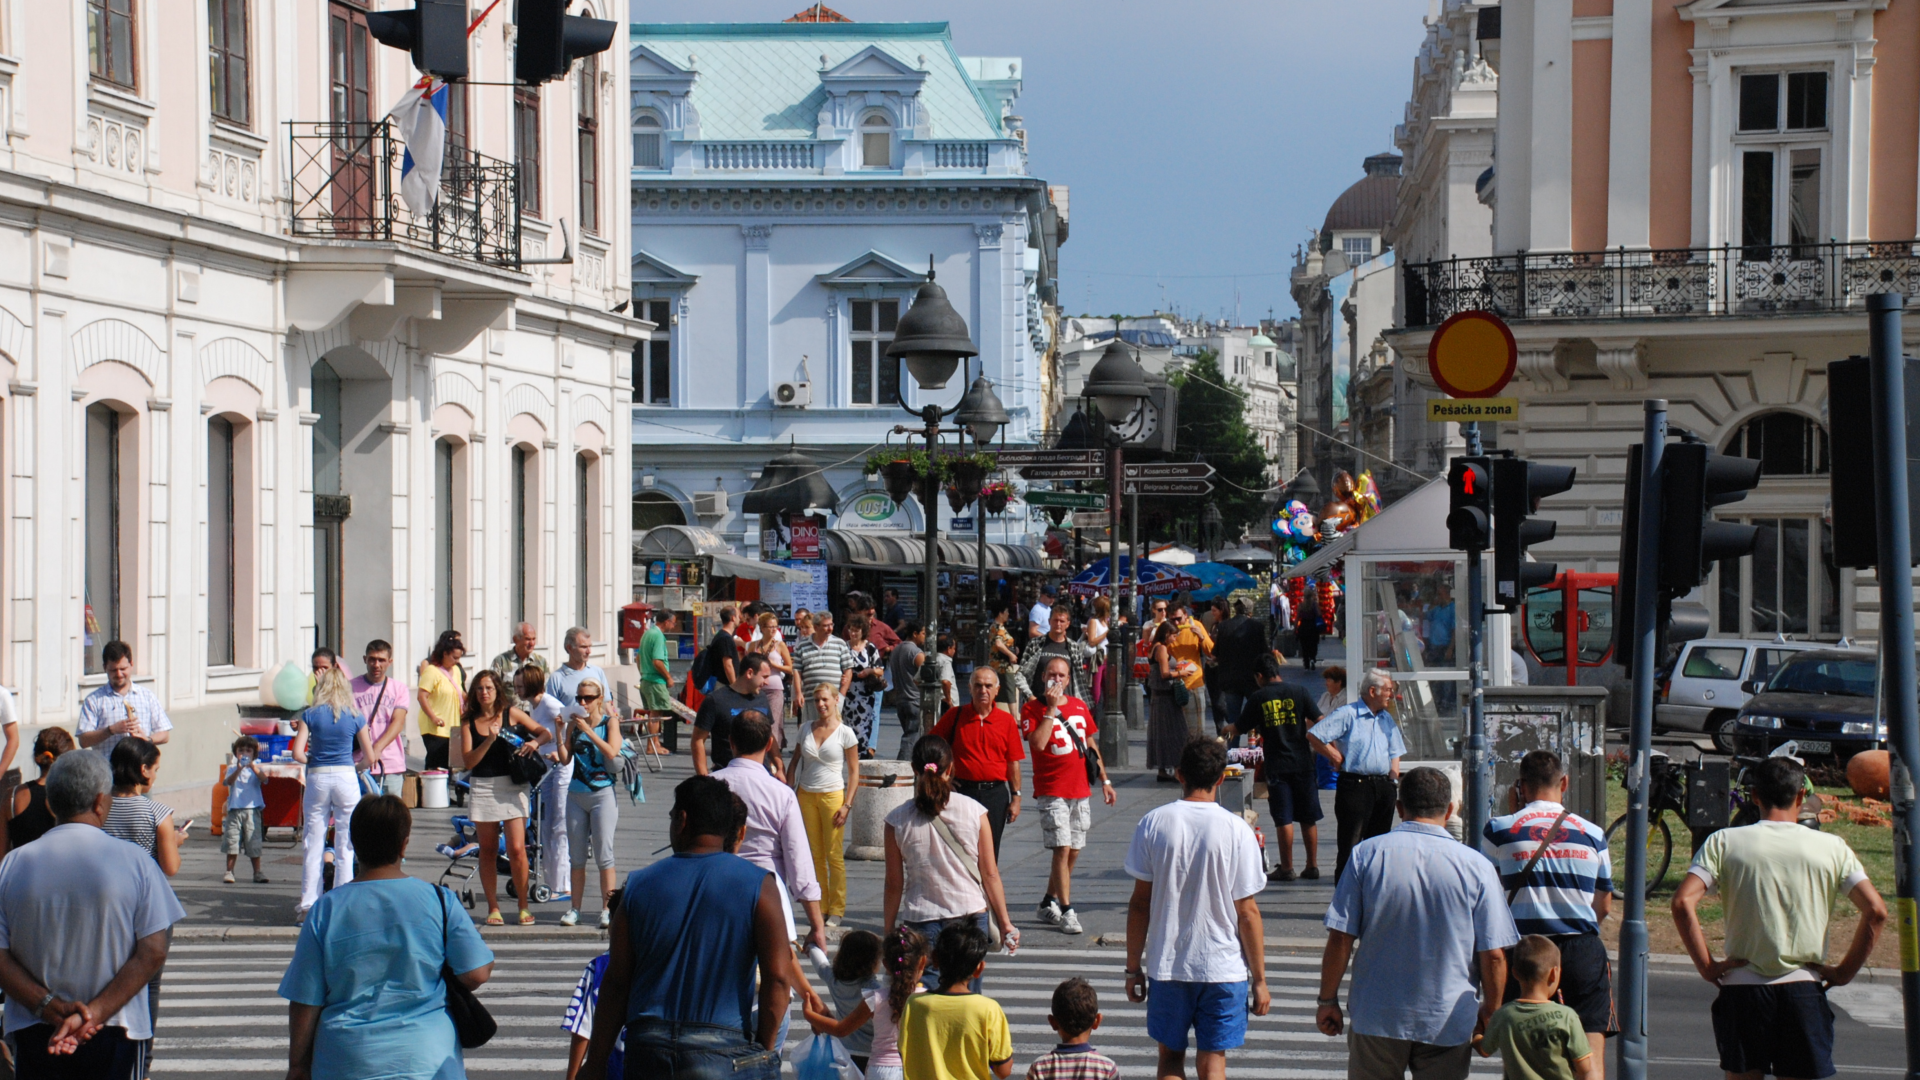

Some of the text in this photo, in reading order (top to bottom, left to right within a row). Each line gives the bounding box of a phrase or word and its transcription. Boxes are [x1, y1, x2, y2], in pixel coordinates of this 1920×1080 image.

[1433, 404, 1512, 415] Pešačka zona
[1056, 454, 1087, 463] Београда
[1058, 468, 1087, 477] фресака
[1143, 483, 1170, 491] Belgrade
[857, 500, 892, 515] LUSH
[792, 526, 819, 538] DINO
[1023, 719, 1030, 732] 3
[1051, 715, 1088, 756] 36
